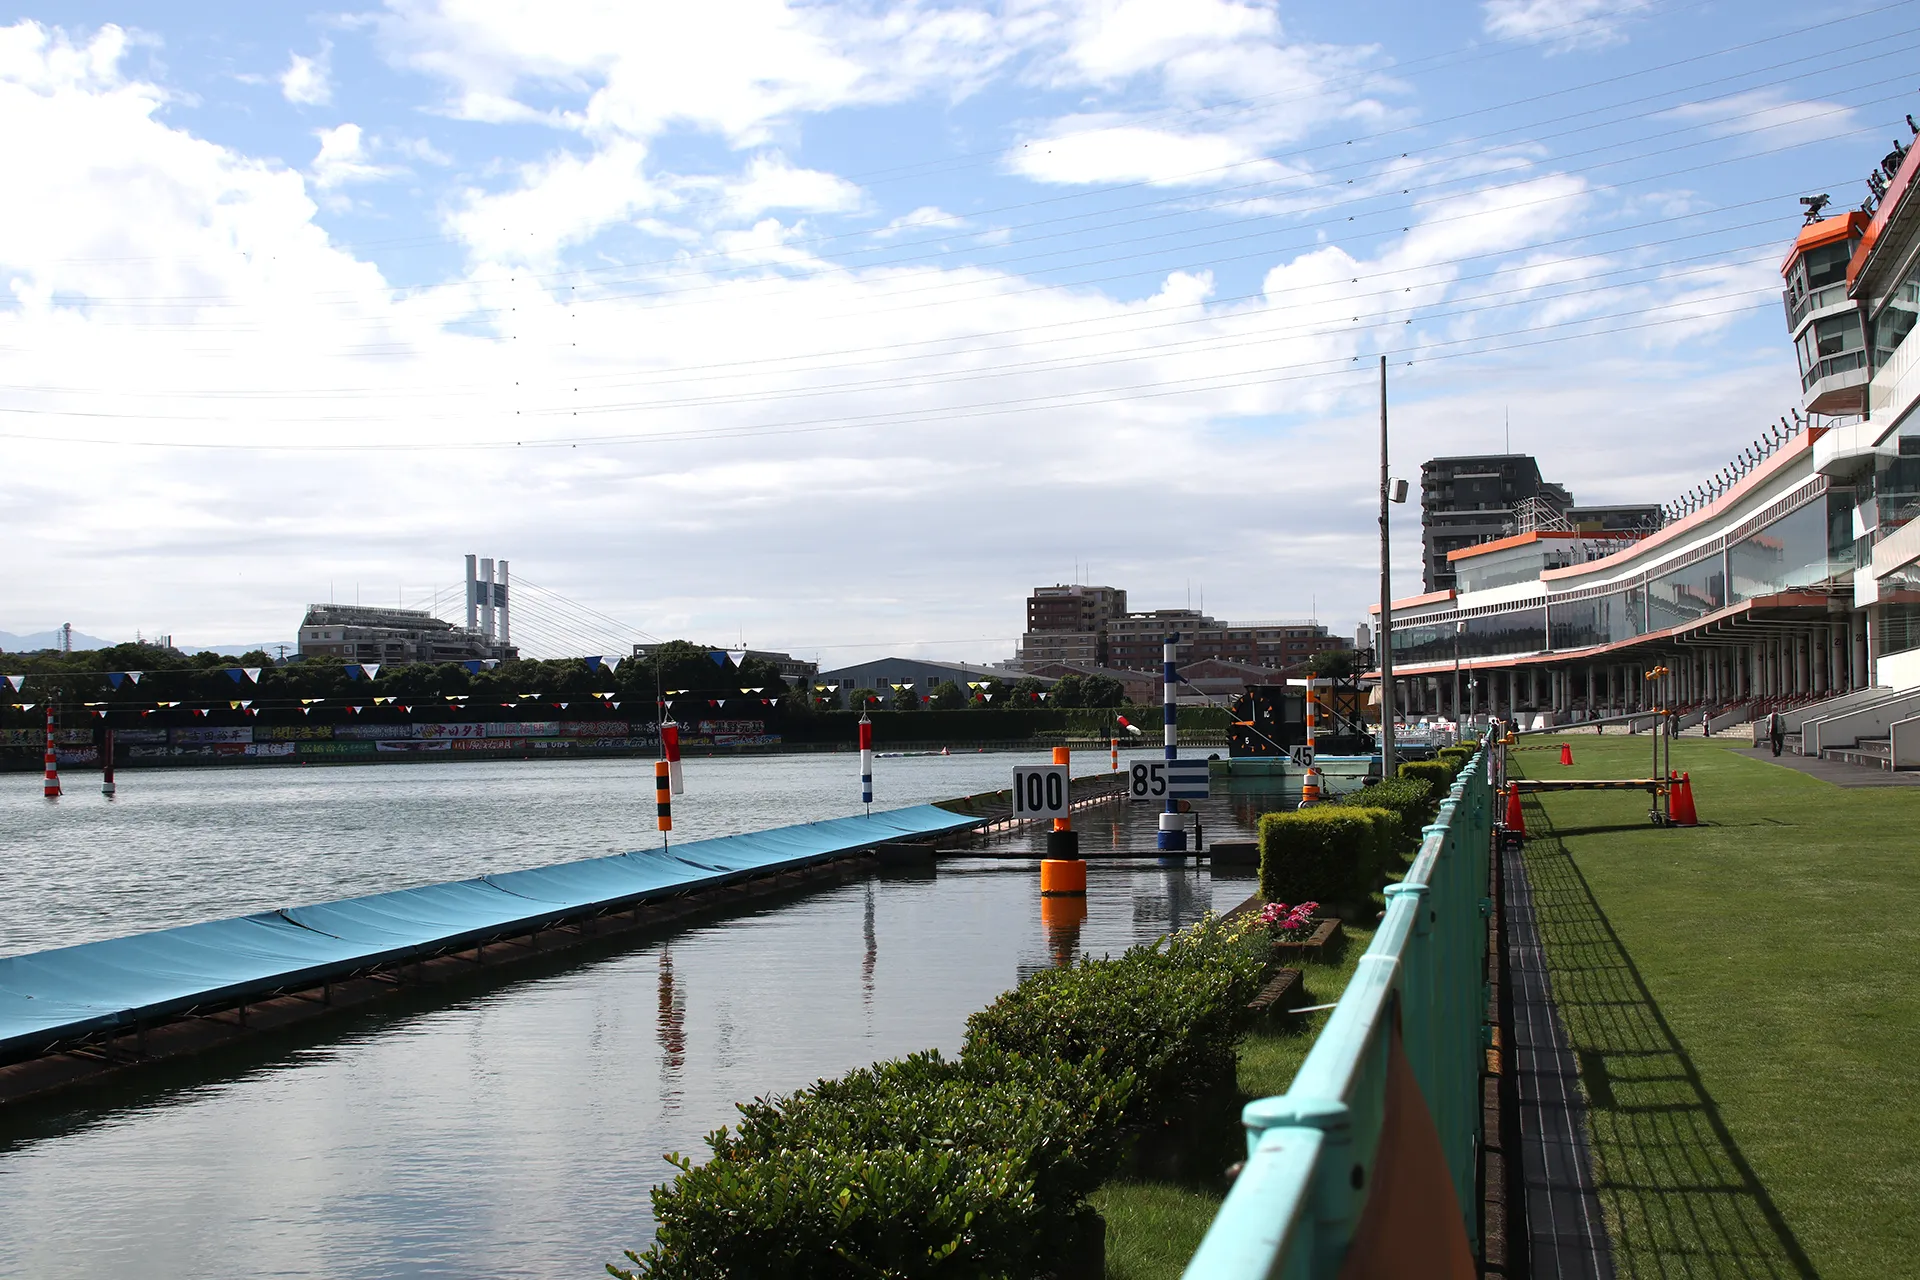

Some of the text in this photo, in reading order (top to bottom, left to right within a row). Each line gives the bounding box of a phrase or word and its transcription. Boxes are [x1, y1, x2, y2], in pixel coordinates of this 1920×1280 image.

[1244, 736, 1250, 744] 5
[1292, 747, 1312, 767] 45
[1016, 772, 1062, 812] 100
[1132, 764, 1167, 796] 85
